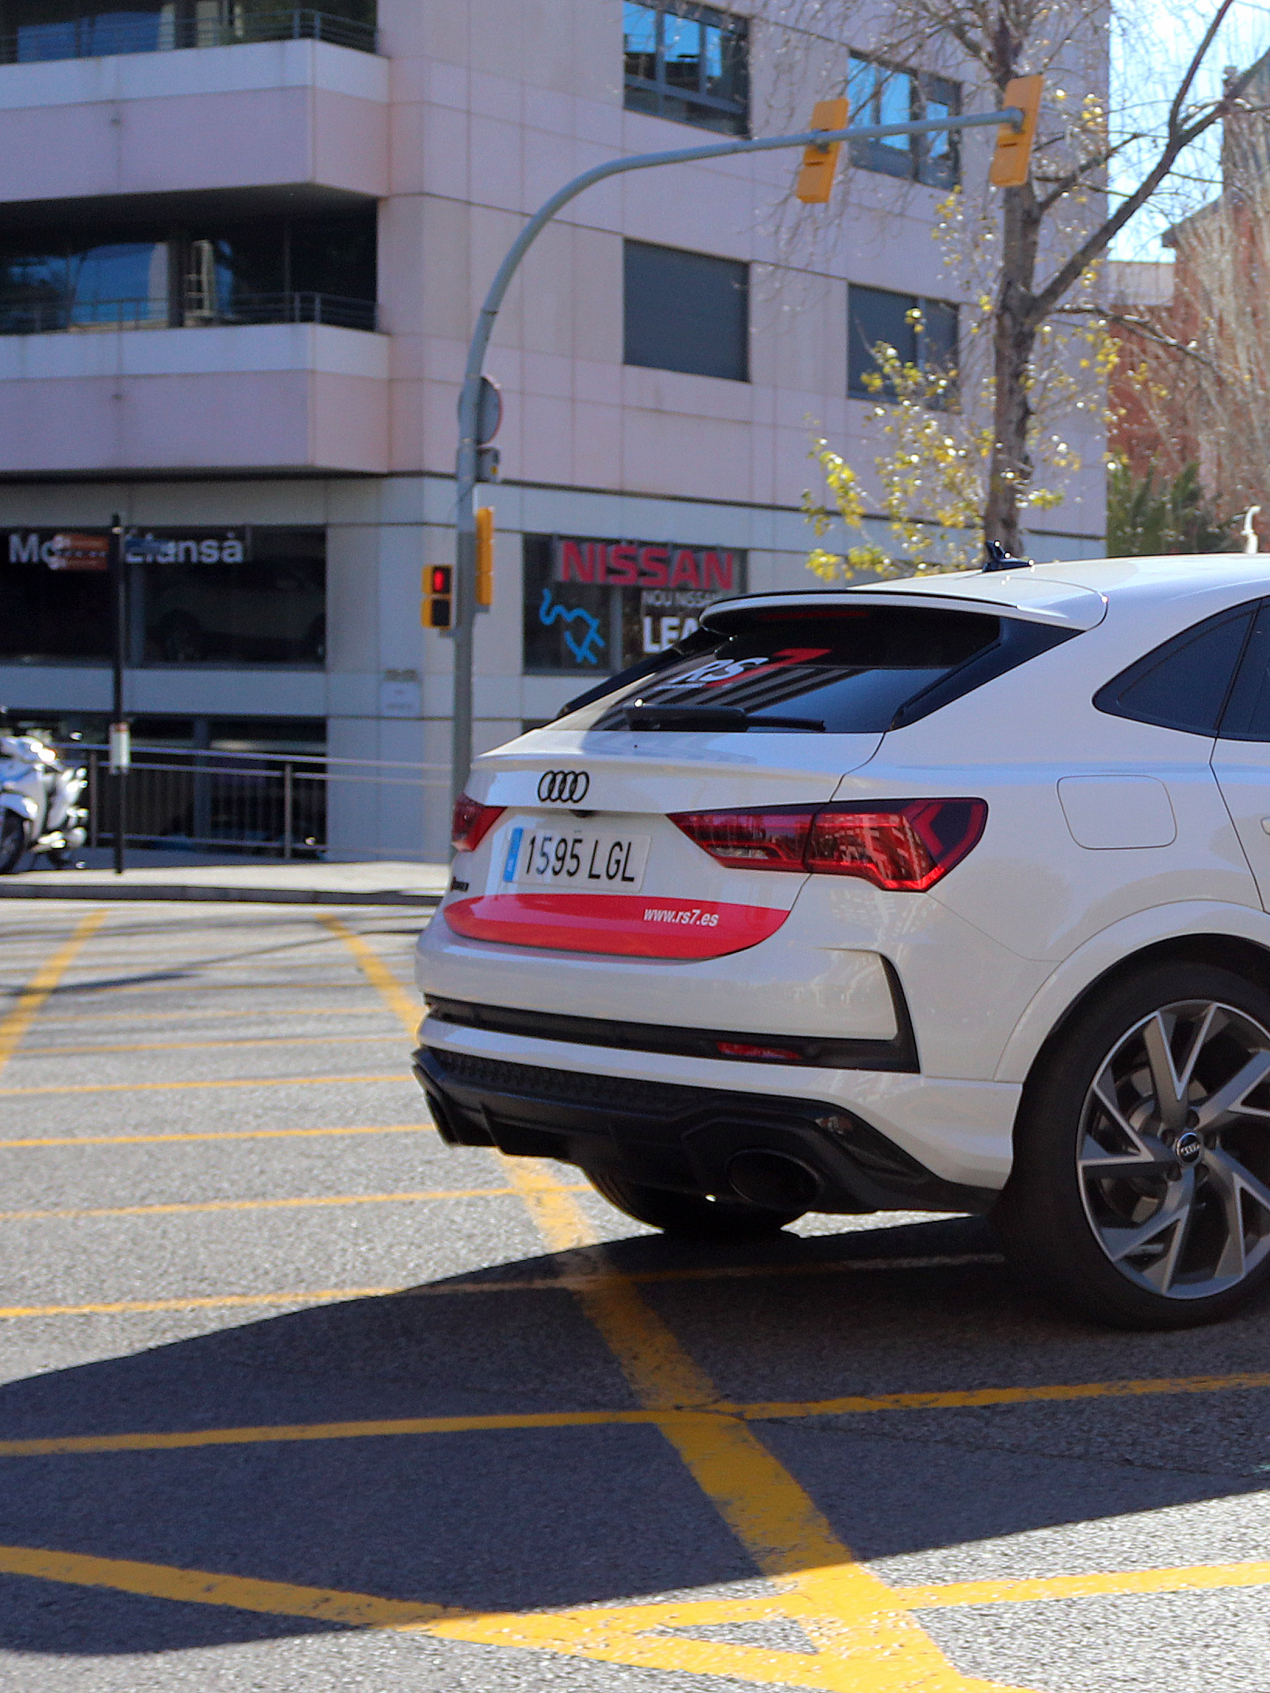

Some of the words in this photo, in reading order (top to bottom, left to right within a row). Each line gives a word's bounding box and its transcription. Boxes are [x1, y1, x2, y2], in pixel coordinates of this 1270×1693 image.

[561, 540, 734, 590] NISSAN
[668, 648, 832, 688] RS7
[526, 836, 583, 878] 1595
[588, 839, 636, 883] LGL
[643, 907, 720, 928] www.rs7.es
